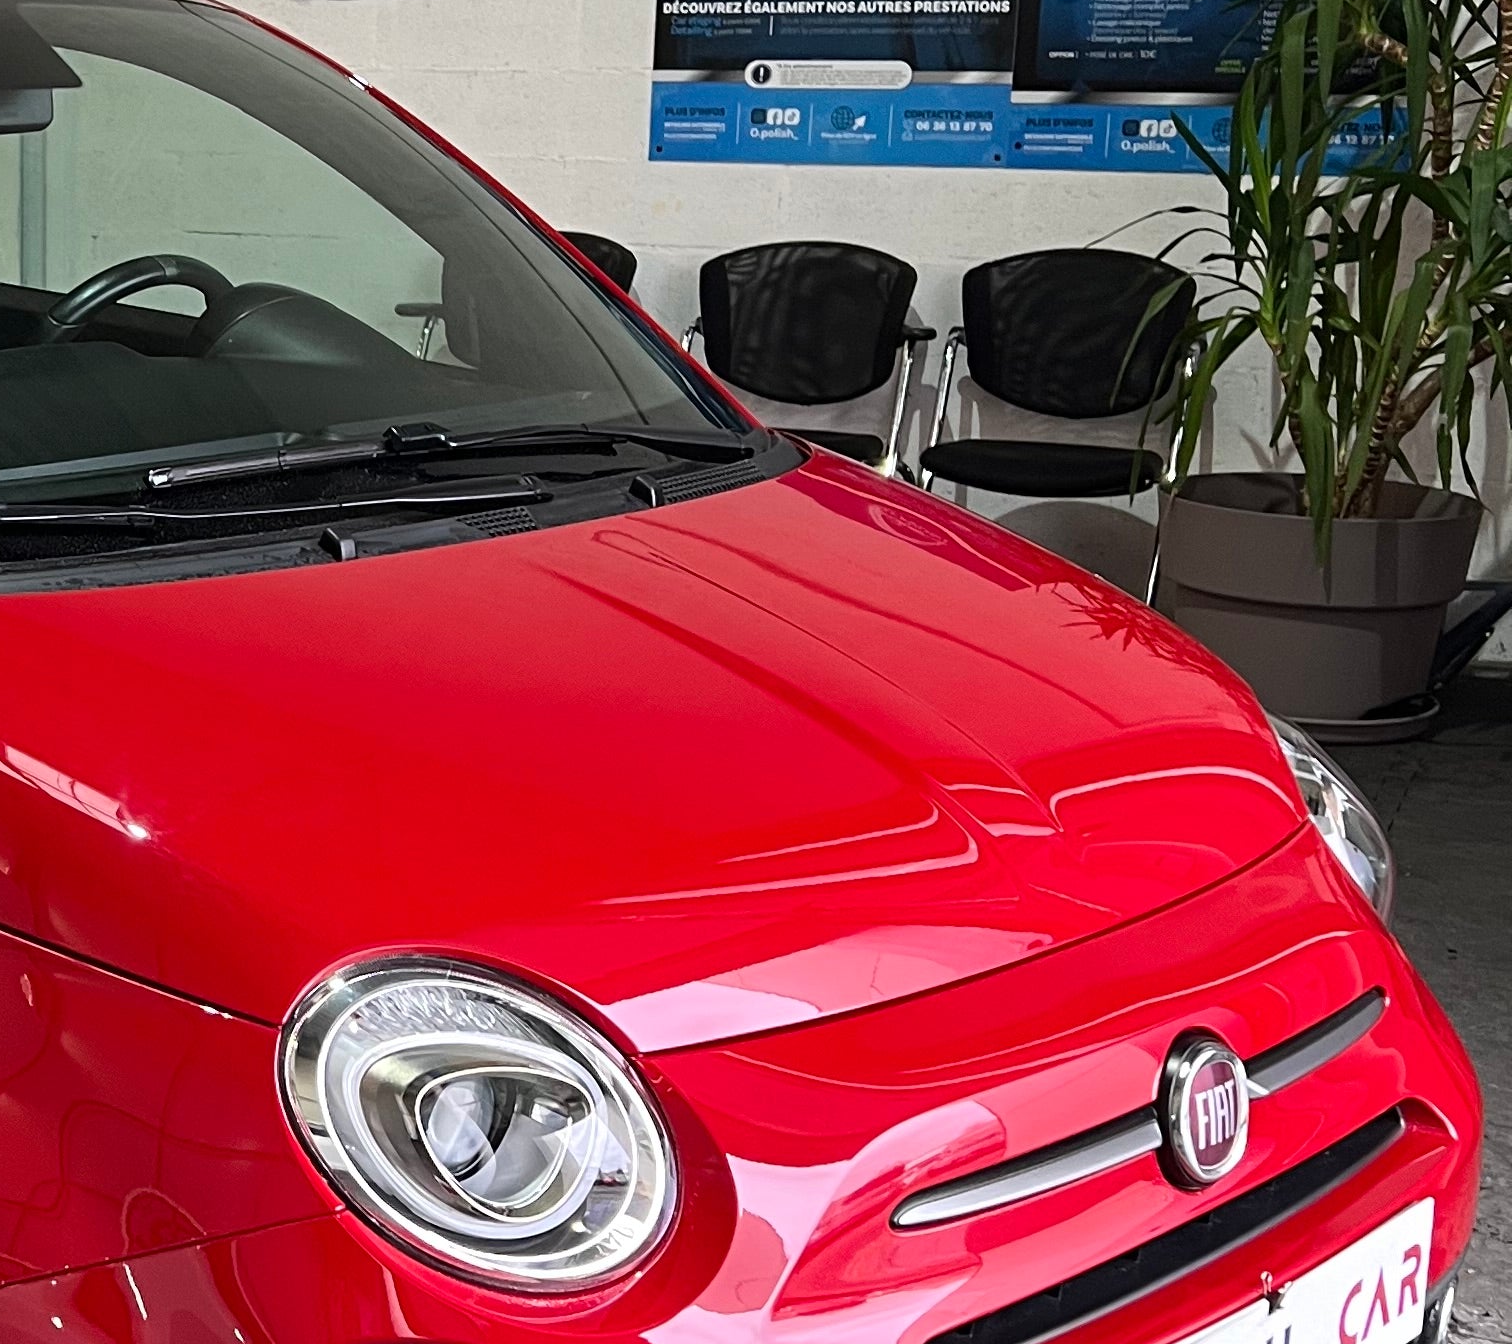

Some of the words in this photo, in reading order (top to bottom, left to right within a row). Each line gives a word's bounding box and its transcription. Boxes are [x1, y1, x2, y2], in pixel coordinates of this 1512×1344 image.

[663, 0, 742, 14] DÉCOUVREZ
[744, 0, 825, 14] ÉGALEMENT
[827, 1, 856, 14] NOS
[857, 1, 912, 13] AUTRES
[914, 0, 1010, 13] PRESTATIONS
[1194, 1078, 1235, 1150] FIAT
